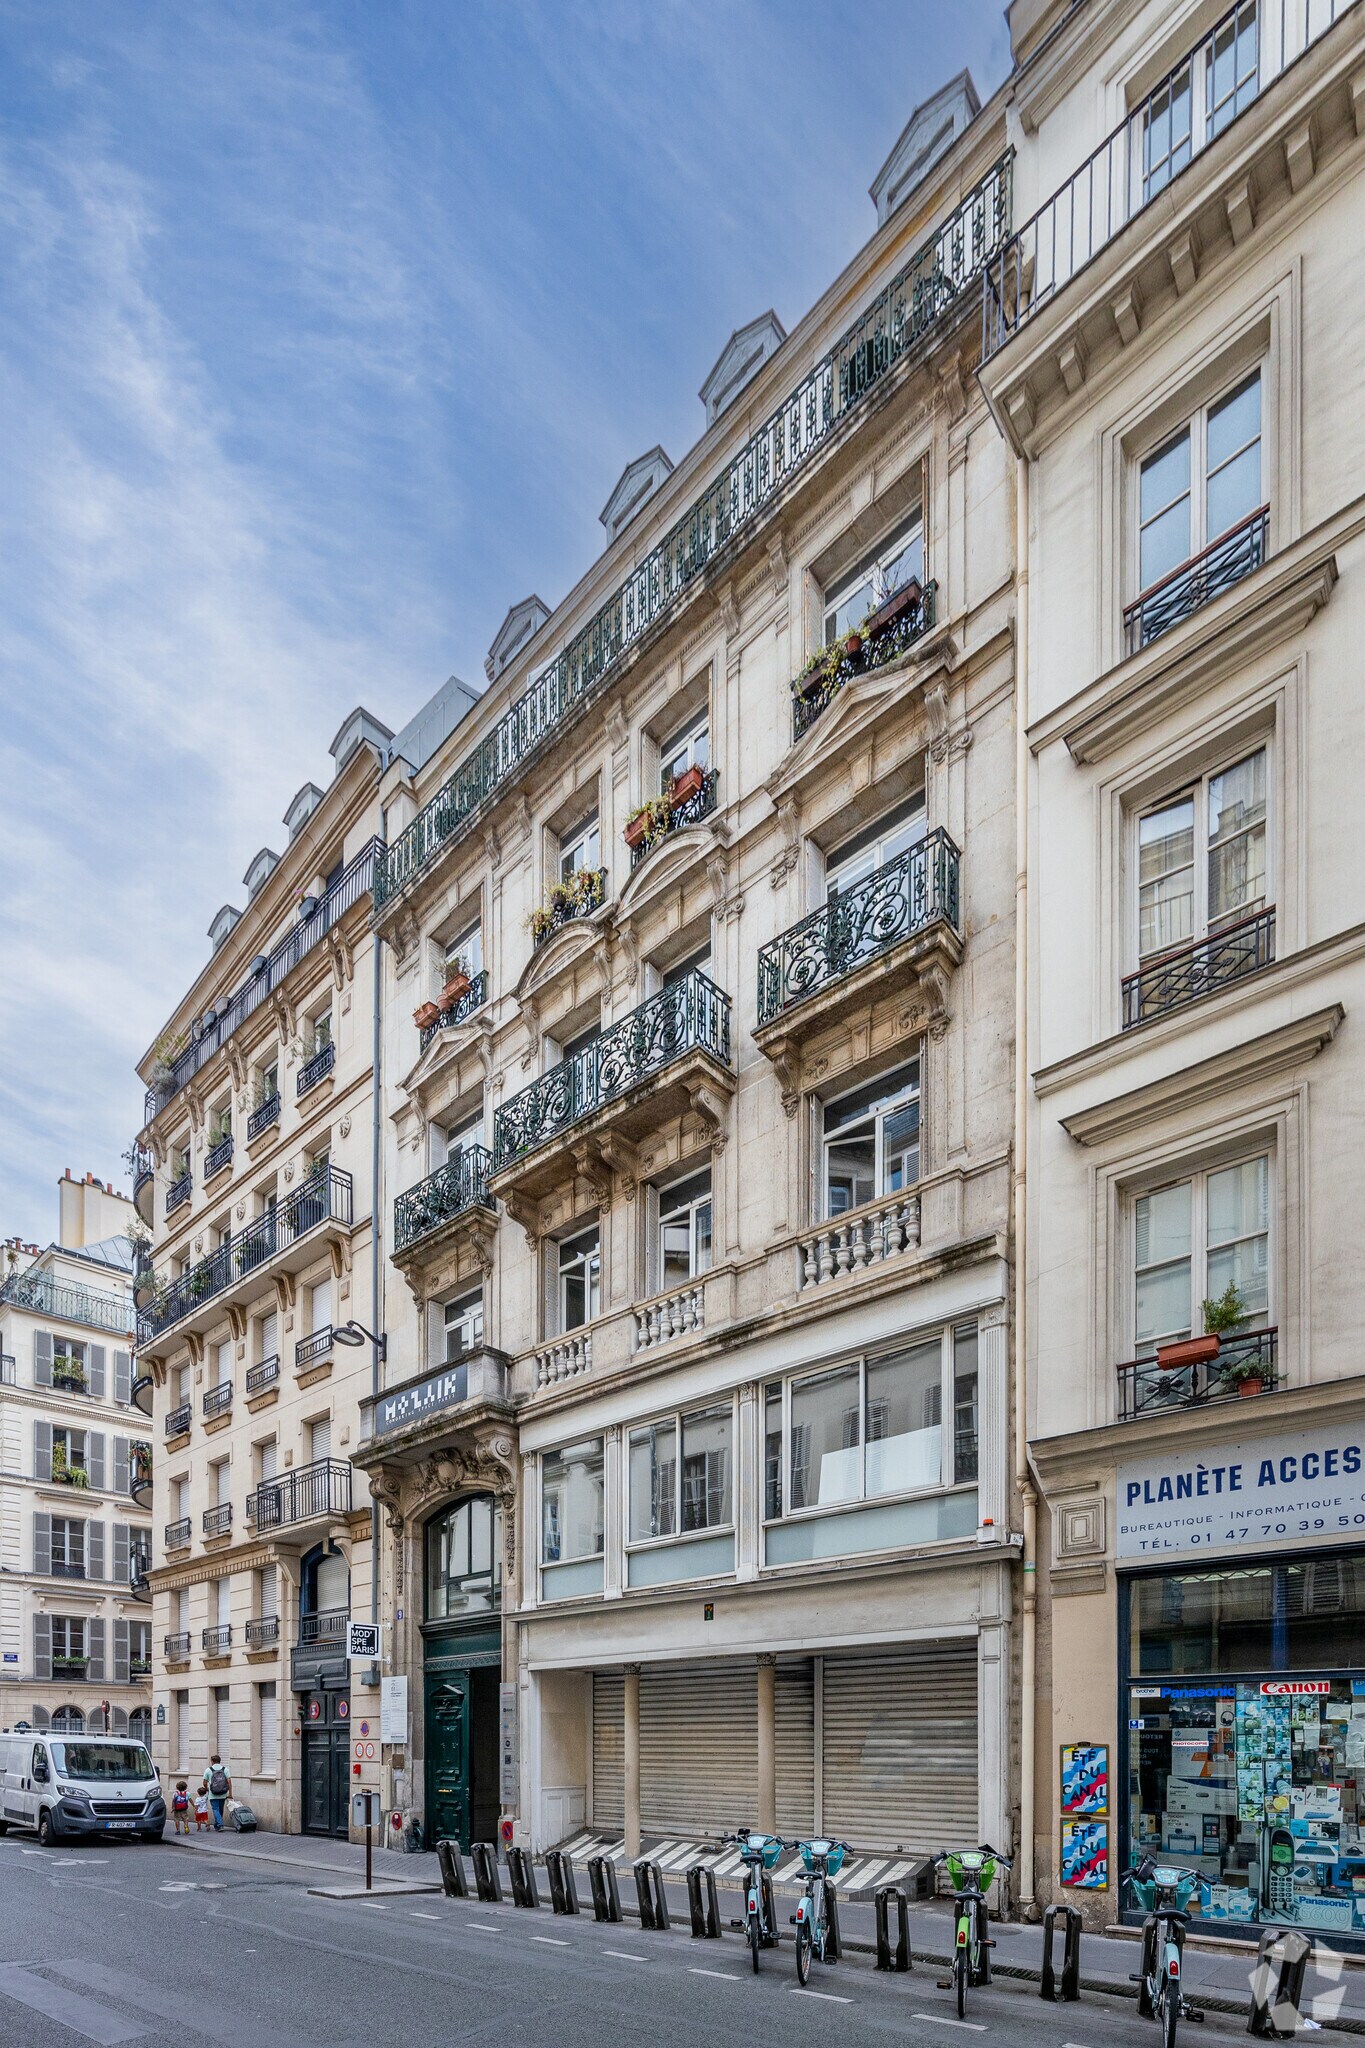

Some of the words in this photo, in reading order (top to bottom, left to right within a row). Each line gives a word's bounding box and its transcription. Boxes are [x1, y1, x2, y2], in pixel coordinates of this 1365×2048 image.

[1127, 1464, 1242, 1507] PLANÈTE
[1257, 1445, 1361, 1488] ACCES
[1120, 1514, 1213, 1534] BUREAUTIQUE
[1230, 1497, 1342, 1520] INFORMATIQUE
[1139, 1538, 1180, 1550] TÉL.
[1190, 1533, 1212, 1544] 01
[1225, 1528, 1249, 1540] 47
[1261, 1523, 1286, 1536] 70
[1298, 1519, 1325, 1531] 39
[1338, 1513, 1365, 1526] 50
[351, 1637, 367, 1645] SPE
[351, 1645, 375, 1654] PARIS
[1161, 1685, 1236, 1699] Panasonic
[1261, 1682, 1329, 1694] Canon
[1071, 1747, 1097, 1766] ÉTÉ
[1079, 1766, 1100, 1781] DU
[1063, 1784, 1107, 1803] CANAL
[1071, 1822, 1097, 1841] ÉTÉ
[1079, 1841, 1100, 1856] DU
[1063, 1859, 1107, 1878] CANAL
[1299, 1896, 1350, 1908] Panasonic
